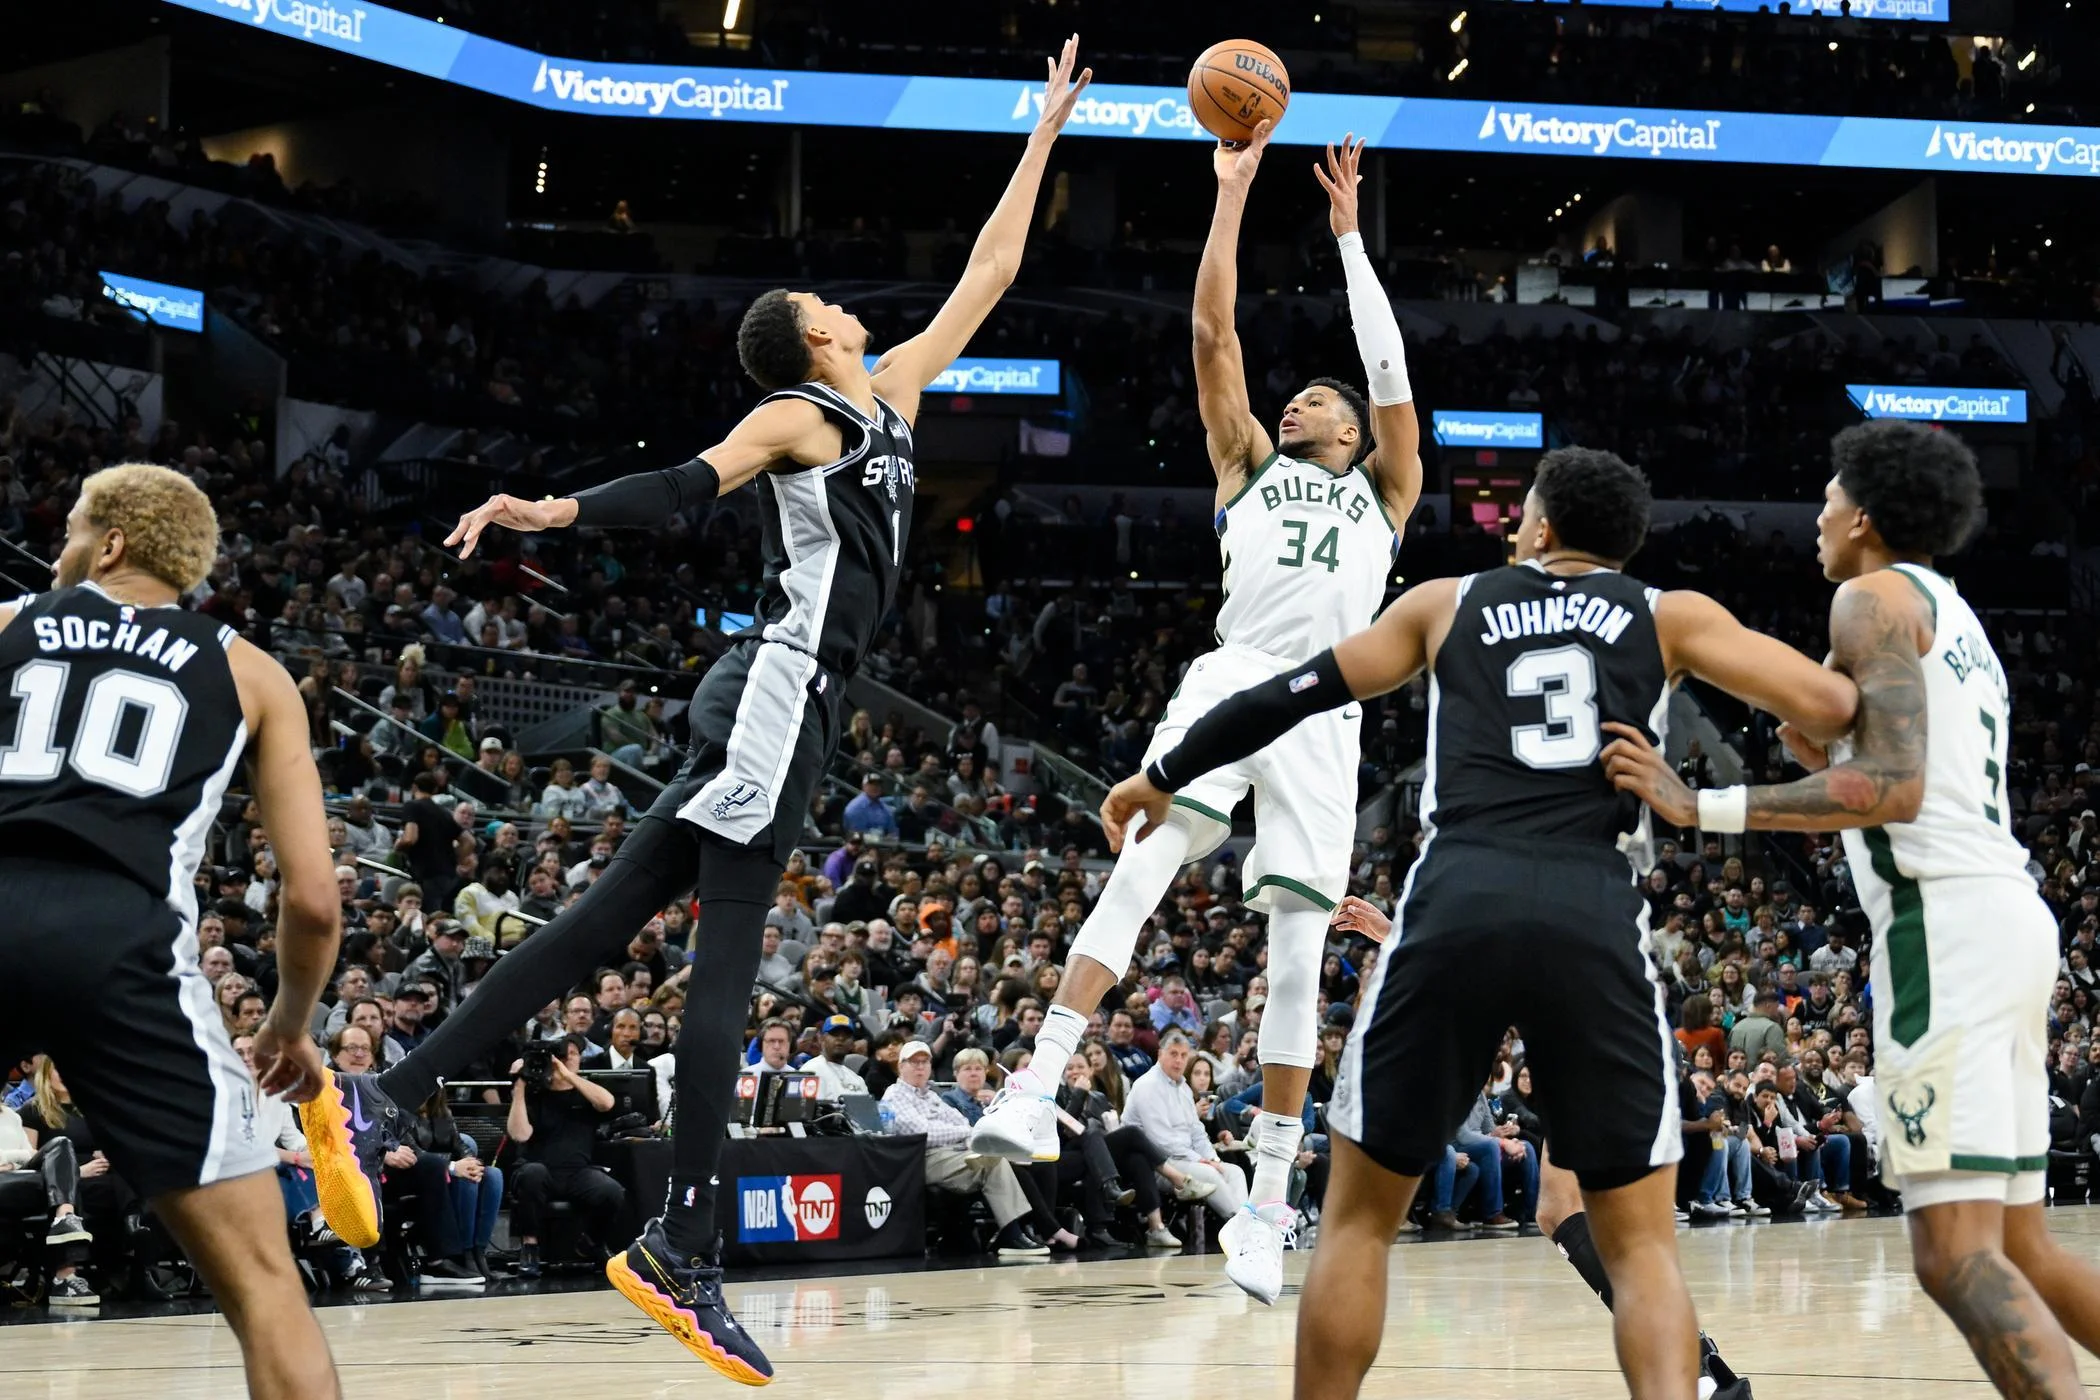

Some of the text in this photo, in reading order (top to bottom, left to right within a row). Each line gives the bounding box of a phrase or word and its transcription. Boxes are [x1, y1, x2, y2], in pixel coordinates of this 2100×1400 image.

[215, 0, 366, 43] yCapital
[548, 68, 789, 117] VictoryCapital
[1235, 54, 1288, 100] Wilson
[1498, 112, 1720, 156] VictoryCapital
[1874, 393, 2010, 420] VictoryCapital
[1260, 476, 1370, 524] BUCKS
[1277, 519, 1340, 573] 34
[1480, 592, 1634, 646] JOHNSON
[33, 615, 200, 673] SOCHAN
[0, 657, 190, 798] 10
[1506, 642, 1602, 769] 3
[743, 1188, 778, 1230] NBA
